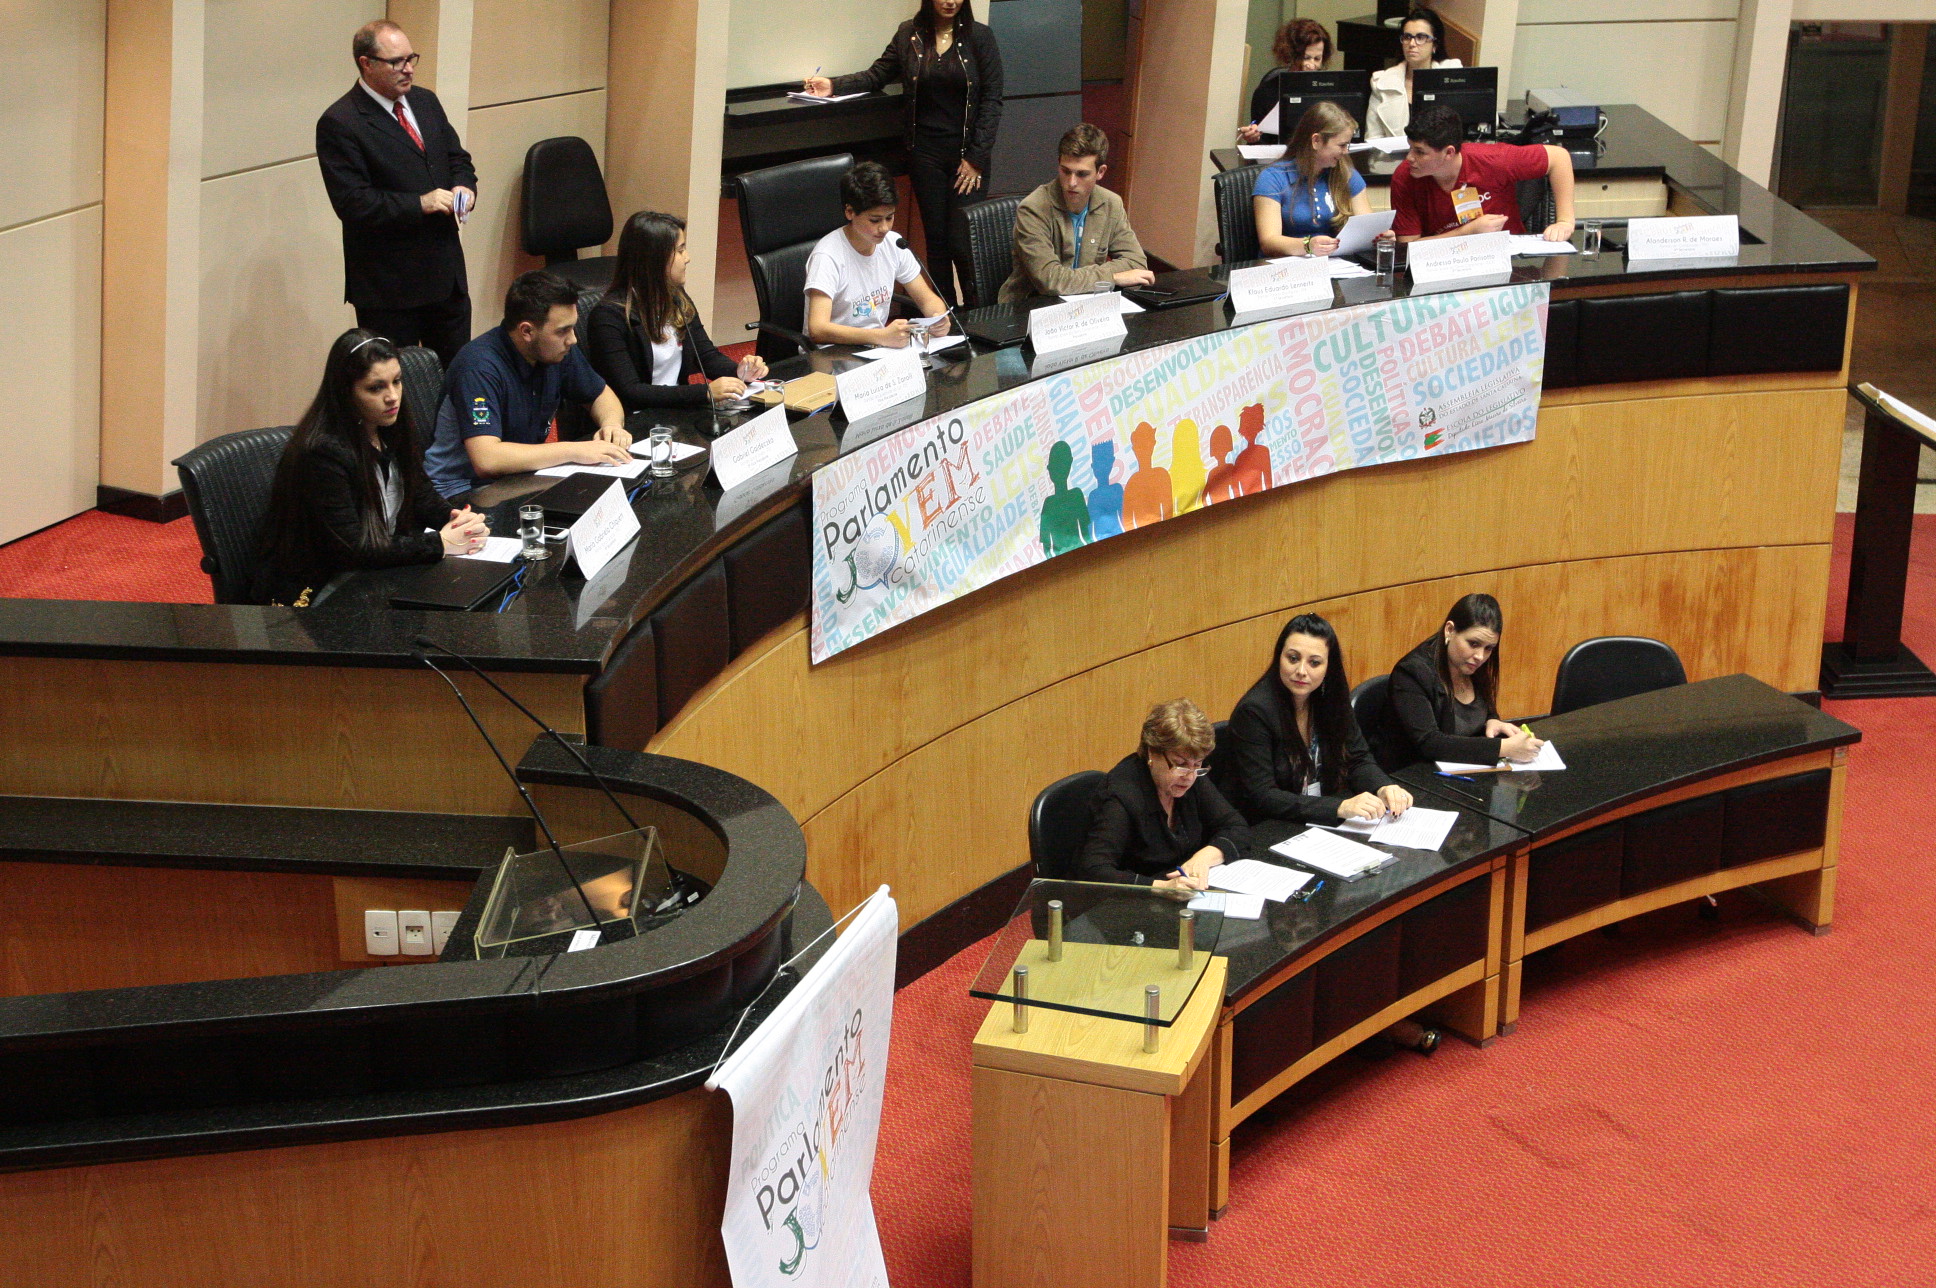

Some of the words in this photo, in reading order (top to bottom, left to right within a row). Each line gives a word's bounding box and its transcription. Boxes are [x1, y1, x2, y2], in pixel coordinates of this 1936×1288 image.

[852, 285, 888, 308] Parlaento
[1313, 291, 1461, 373] CULTURA
[1399, 301, 1490, 363] DEBATE
[1488, 282, 1550, 322] IGUA
[1407, 335, 1481, 383] CULTURA
[1482, 309, 1535, 349] LEIS
[1412, 330, 1539, 406] SOCIEDADE
[973, 391, 1031, 452] DEBATE
[1114, 323, 1274, 446] IGUALDADE
[1182, 353, 1283, 428] TRANSPARÊNCIA
[1446, 415, 1471, 431] ESCOLA
[1472, 408, 1484, 419] DO
[1485, 387, 1526, 413] LEGISLATIVO
[820, 478, 868, 527] Programa
[822, 417, 964, 561] Parlamento
[989, 441, 1045, 512] LEIS
[890, 486, 986, 584] catarinense
[933, 491, 1027, 593] IGUALDADE
[756, 1007, 862, 1231] Parlamento
[751, 1121, 806, 1195] Programa
